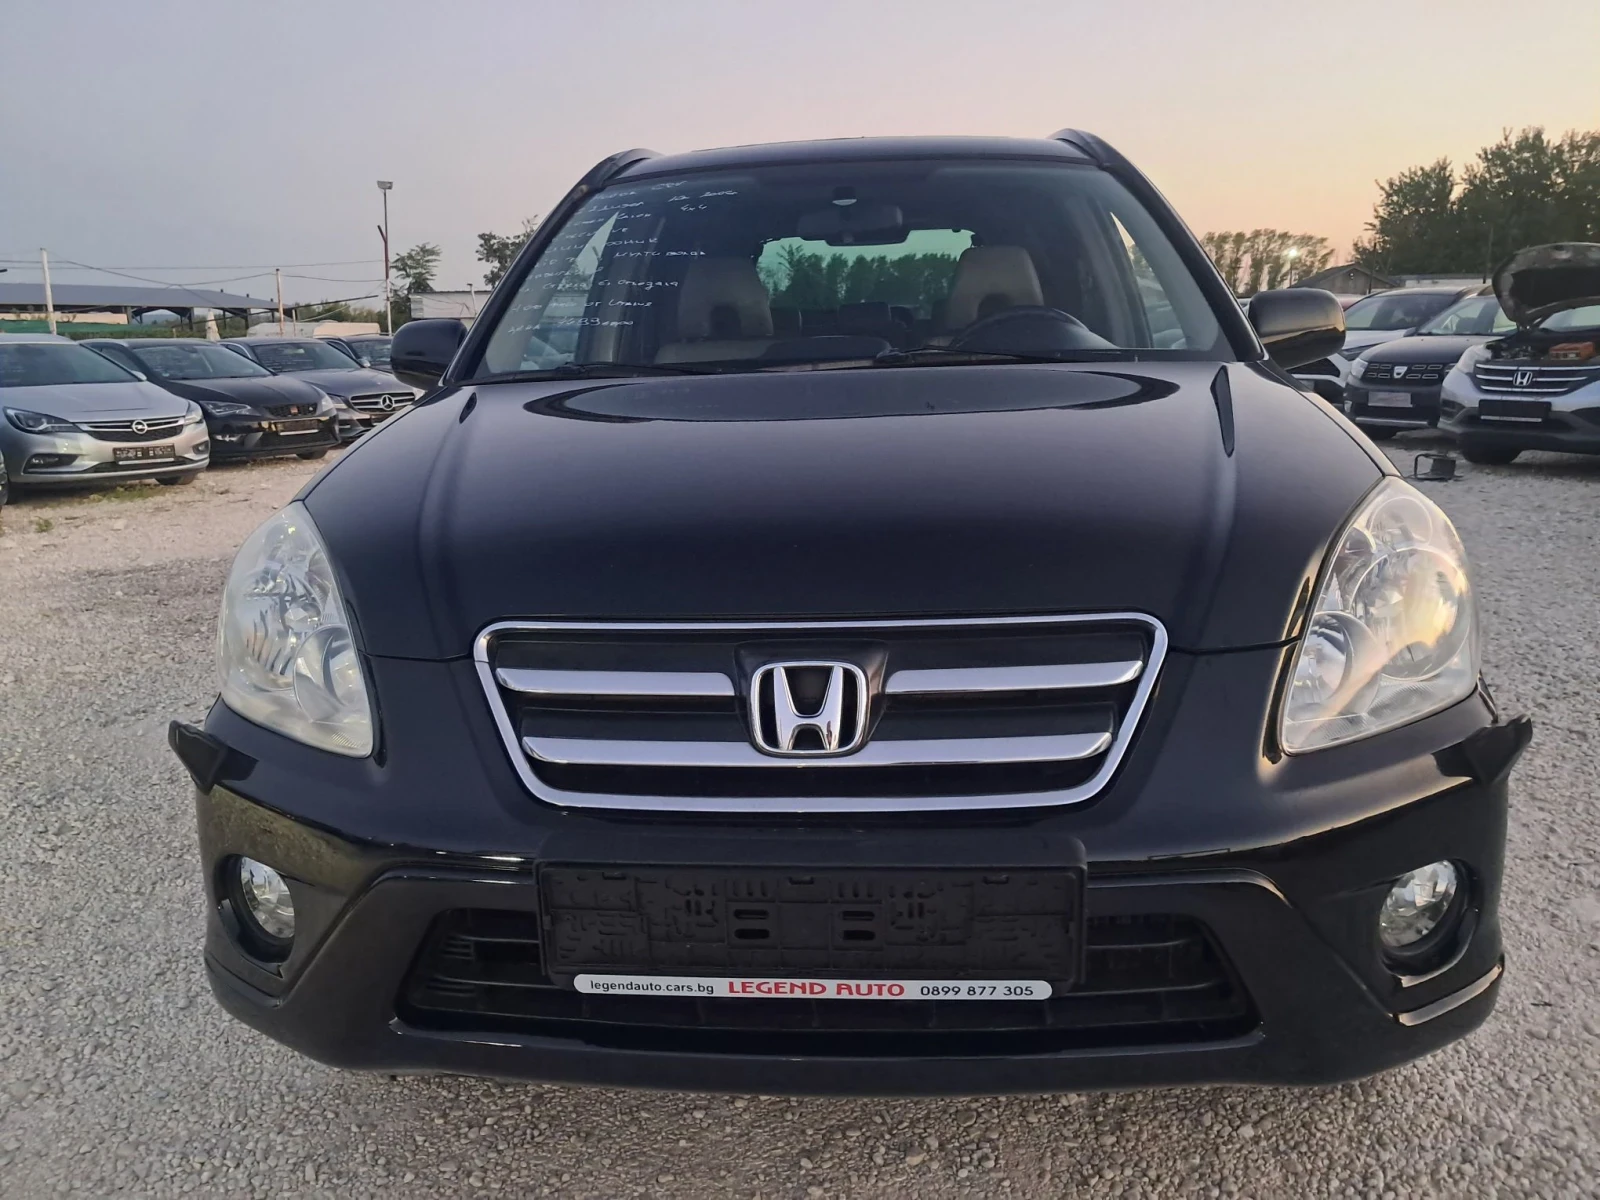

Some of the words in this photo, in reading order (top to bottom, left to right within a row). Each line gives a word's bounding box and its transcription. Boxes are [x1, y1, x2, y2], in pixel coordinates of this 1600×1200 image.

[590, 980, 715, 995] legendauto.cars.bg
[728, 981, 827, 995] LEGEND
[836, 983, 905, 997] AUTO
[920, 985, 962, 997] 0899
[966, 985, 997, 997] 877
[1002, 985, 1034, 997] 305
